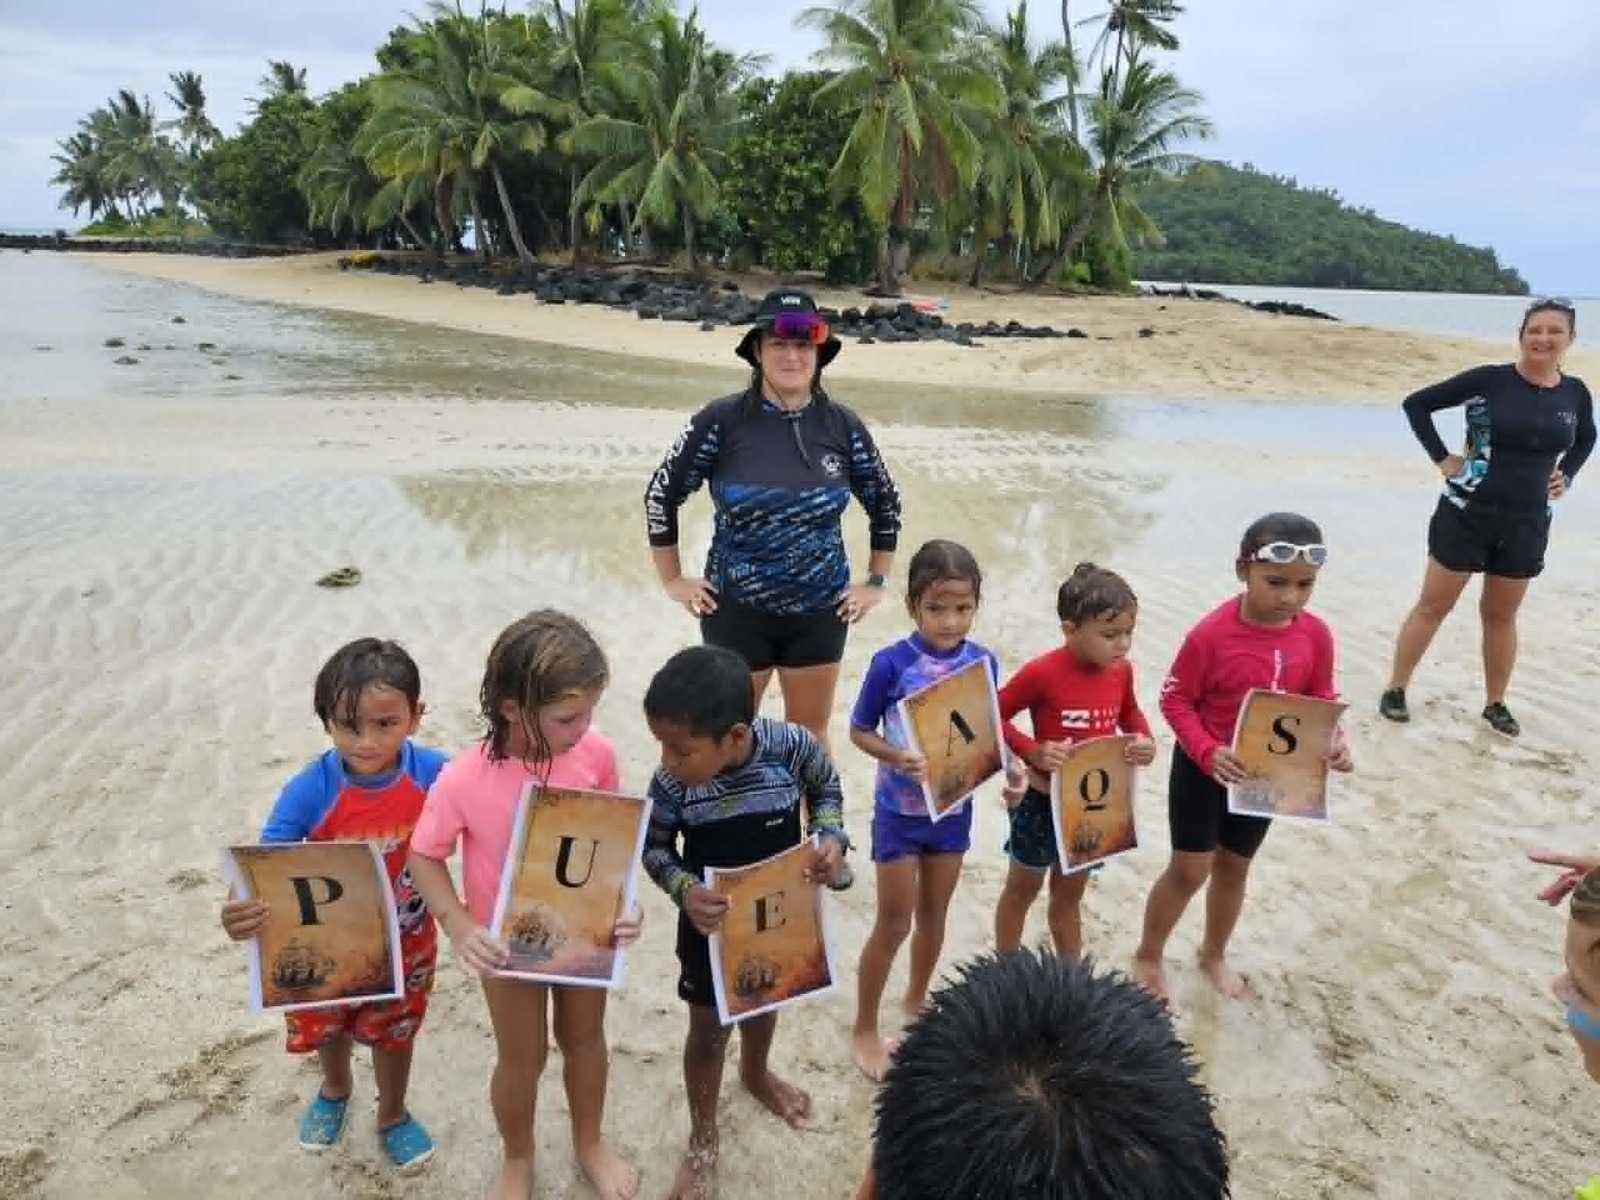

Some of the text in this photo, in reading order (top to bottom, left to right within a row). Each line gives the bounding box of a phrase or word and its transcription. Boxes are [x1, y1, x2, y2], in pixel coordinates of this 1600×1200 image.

[946, 710, 975, 756] A
[1268, 715, 1300, 755] S
[1080, 768, 1109, 812] Q
[556, 836, 600, 888] U
[288, 876, 343, 925] P
[754, 890, 787, 933] E
